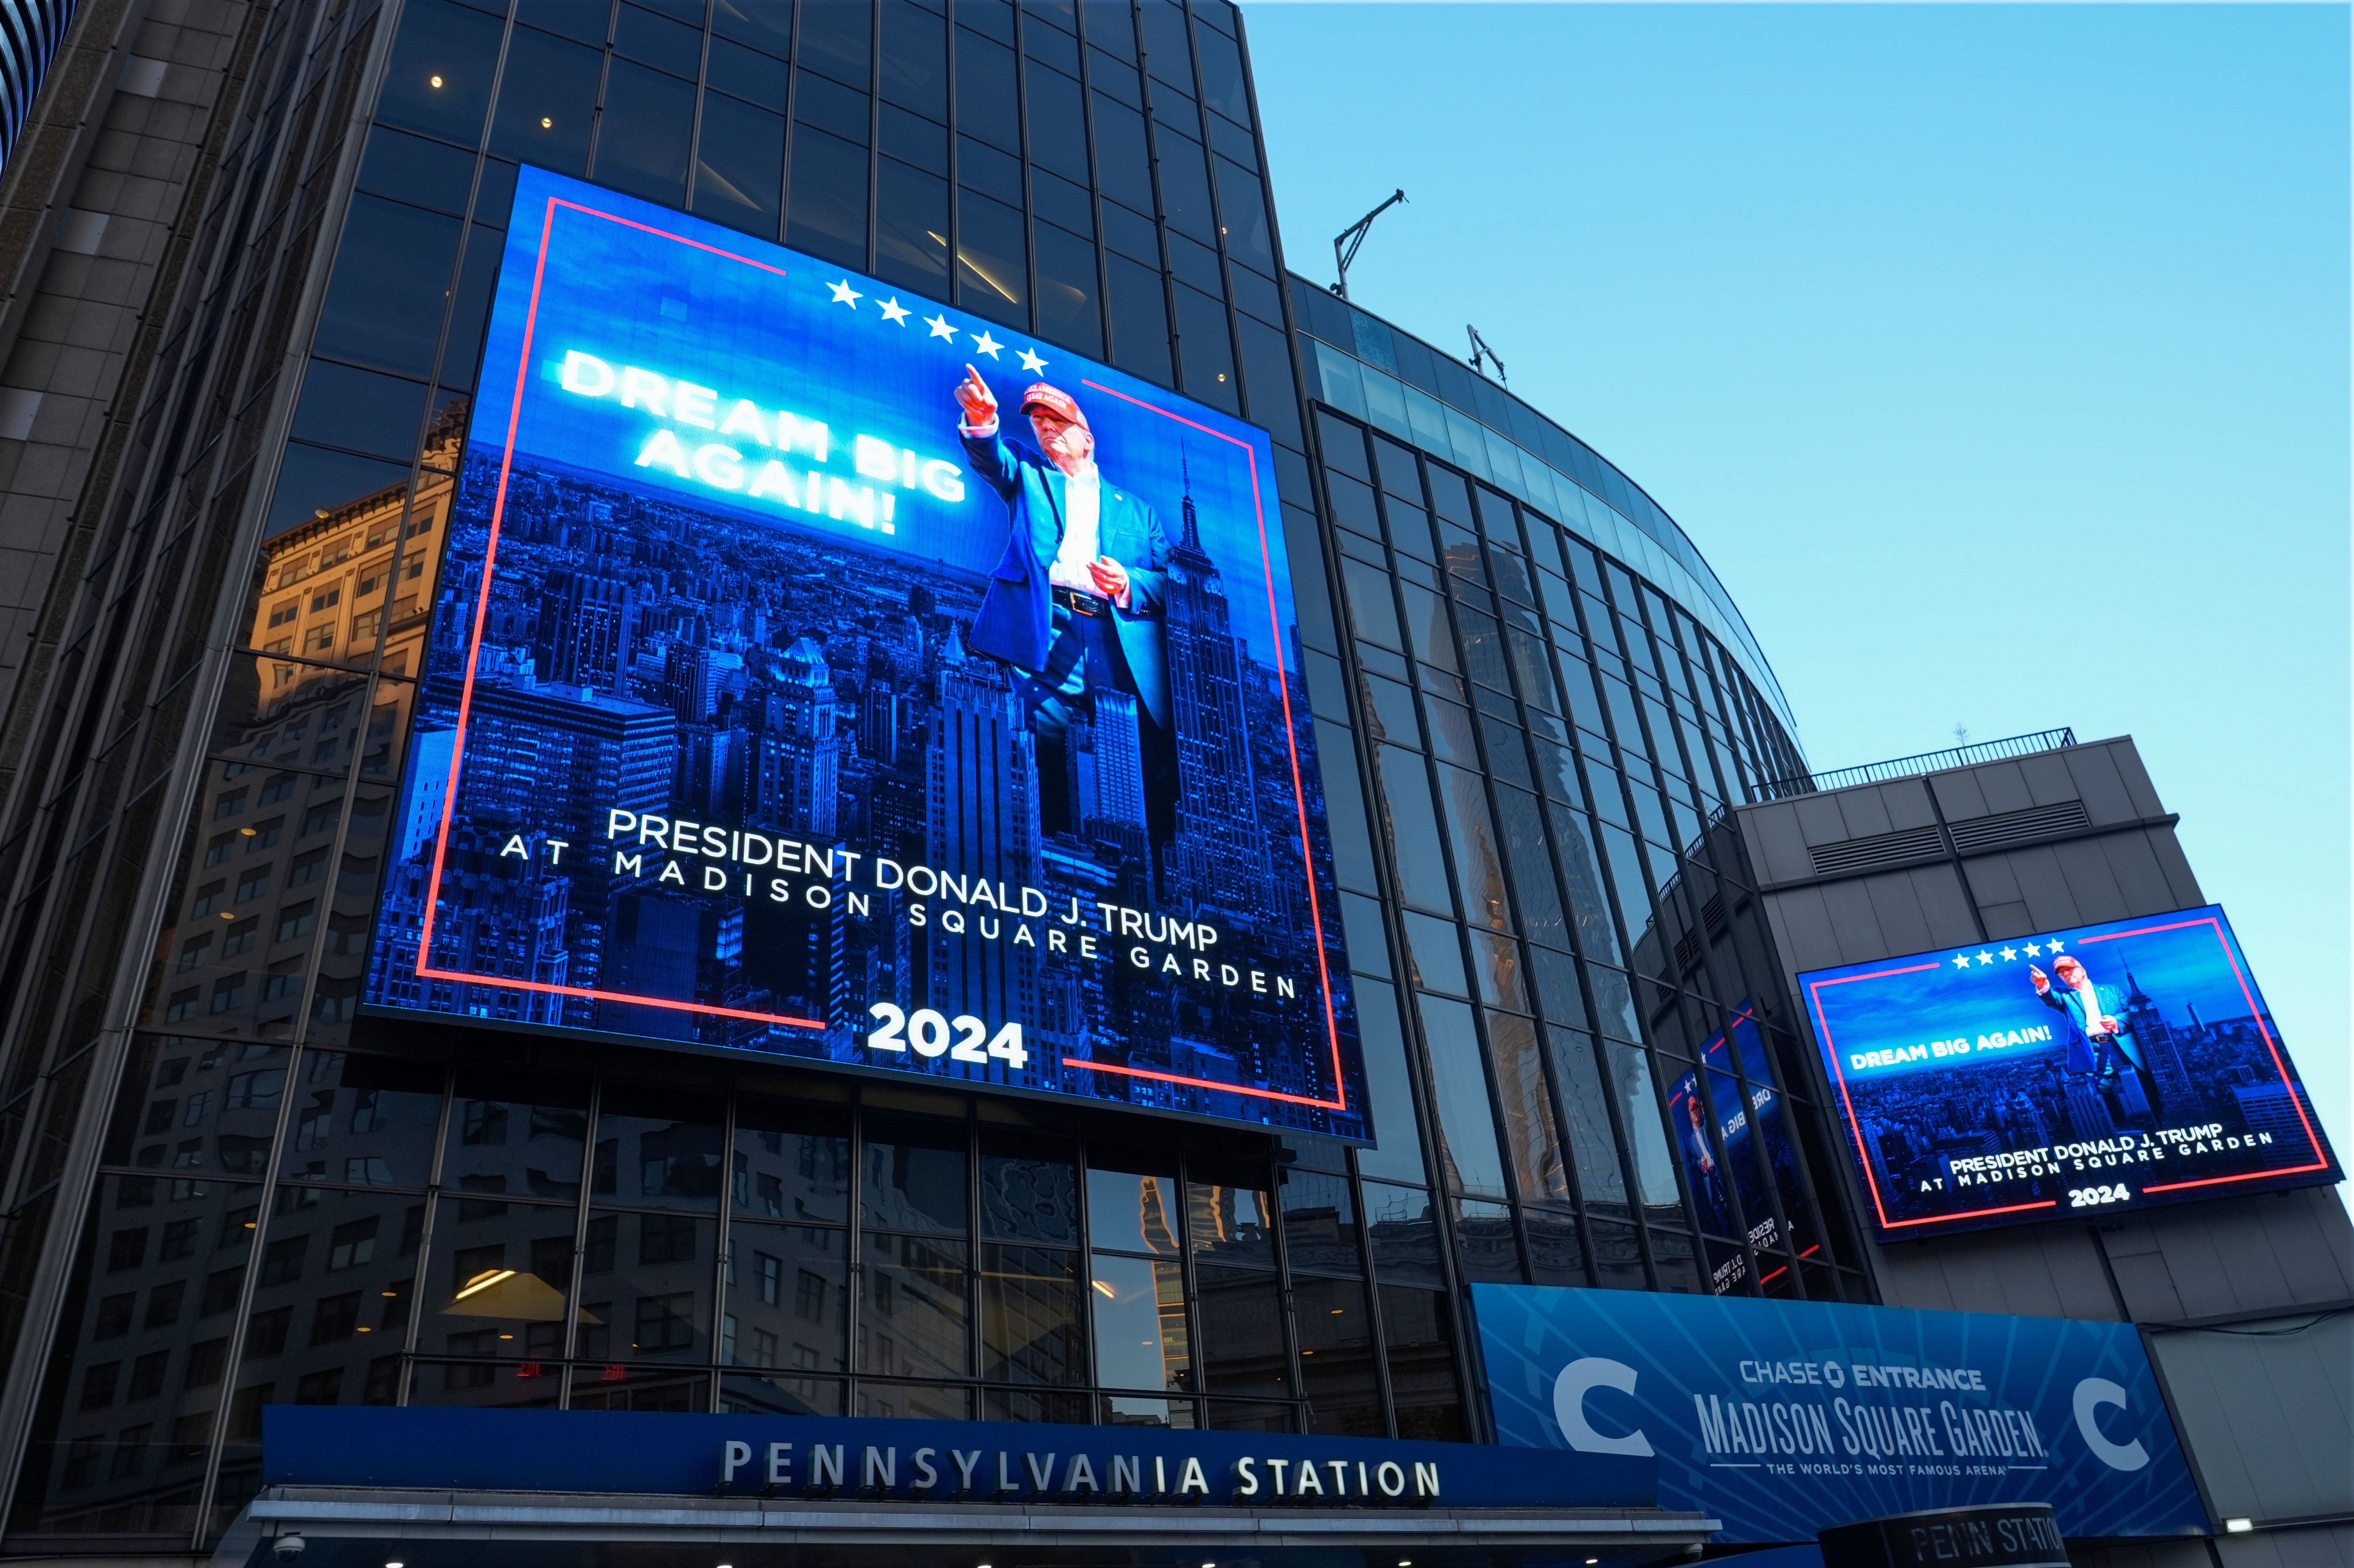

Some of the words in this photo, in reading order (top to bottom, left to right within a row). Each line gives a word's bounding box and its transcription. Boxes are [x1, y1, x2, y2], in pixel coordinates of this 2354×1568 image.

[560, 350, 829, 462] DREAM
[854, 434, 964, 502] BIG
[635, 429, 895, 534] AGAIN!
[608, 809, 861, 881] PRESIDENT
[877, 858, 1047, 916] DONALD
[1062, 898, 1086, 926] J.
[1097, 903, 1216, 951] TRUMP
[501, 835, 569, 864] AT
[615, 852, 868, 916] MADISON
[910, 904, 1097, 958] SQUARE
[1131, 947, 1294, 998] GARDEN
[868, 1003, 1027, 1068] 2024
[1851, 1044, 1928, 1069] DREAM
[1931, 1039, 1970, 1057] BIG
[1977, 1026, 2052, 1051] AGAIN!
[1921, 1178, 1942, 1191] AT
[1958, 1162, 2060, 1186] MADISON
[2074, 1148, 2164, 1170] SQUARE
[2179, 1133, 2272, 1155] GARDEN
[1950, 1148, 2048, 1174] PRESIDENT
[2054, 1137, 2134, 1159] DONALD
[2141, 1134, 2154, 1147] J.
[2156, 1124, 2222, 1144] TRUMP
[2069, 1183, 2130, 1207] 2024
[1740, 1360, 1822, 1384] CHASE
[1855, 1365, 1986, 1390] ENTRANCE
[1554, 1357, 1655, 1456] C
[1694, 1394, 1834, 1454] MADISON
[1834, 1397, 1943, 1460] SQUARE
[2073, 1378, 2149, 1470] C
[726, 1441, 1209, 1493] PENNSYLVANIA
[1238, 1457, 1439, 1496] STATION
[1766, 1463, 1795, 1474] THE
[1799, 1463, 1863, 1475] WORLD'S
[1867, 1464, 1903, 1475] MOST
[1909, 1465, 1960, 1476] FAMOUS
[1910, 1521, 1994, 1561] PENN
[1996, 1517, 2063, 1553] STATIO
